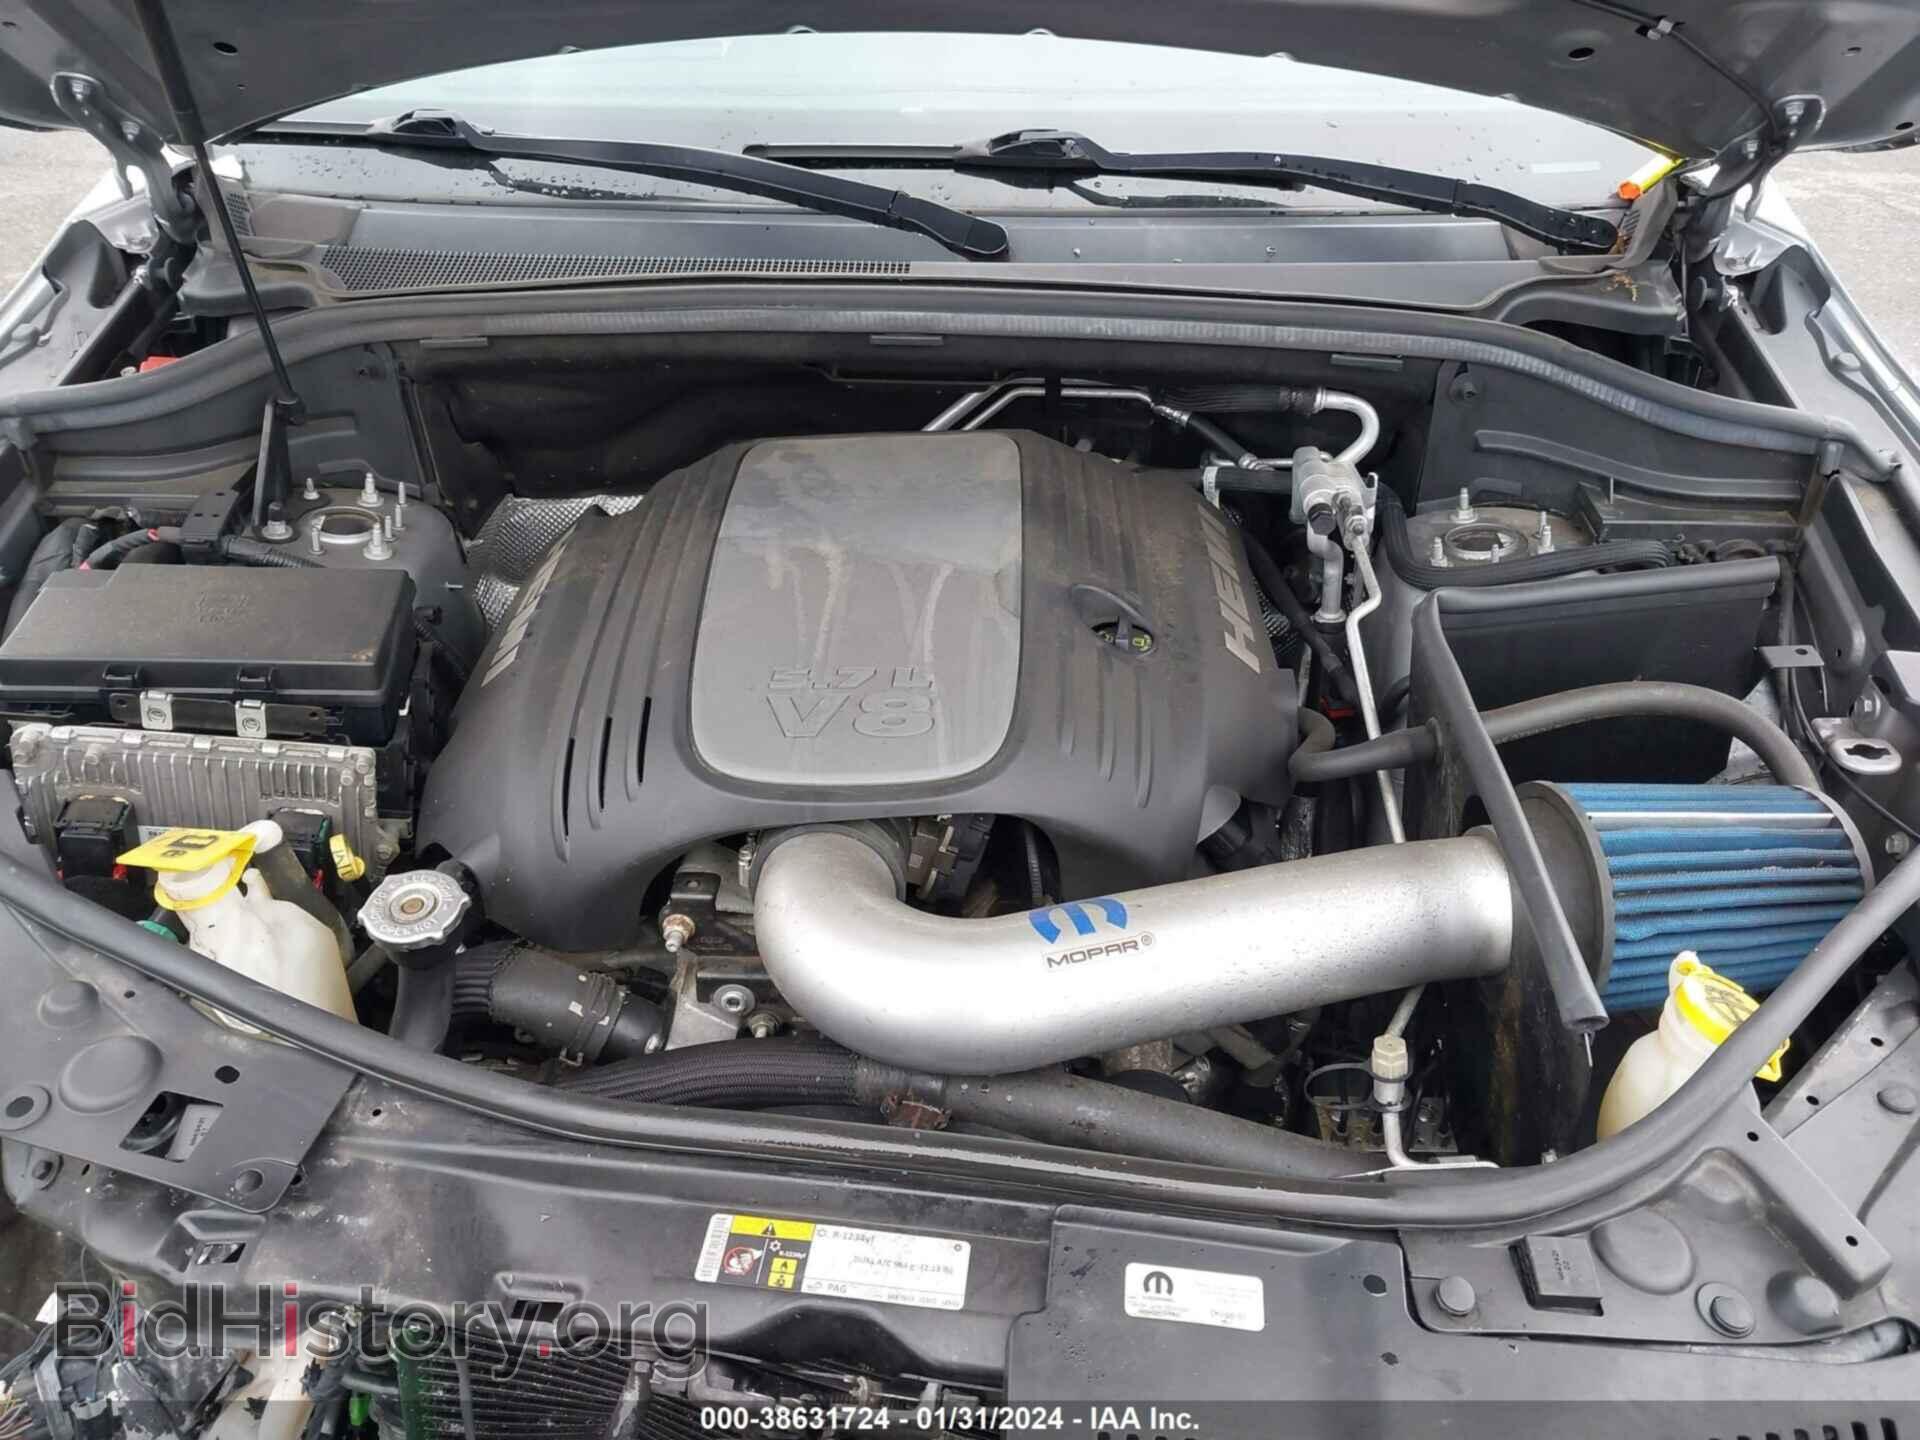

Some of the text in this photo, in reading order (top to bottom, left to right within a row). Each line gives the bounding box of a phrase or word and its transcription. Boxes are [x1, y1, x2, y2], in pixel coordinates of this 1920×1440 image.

[1197, 503, 1261, 674] HEMI
[765, 692, 936, 740] V8
[827, 1283, 848, 1295] PAG
